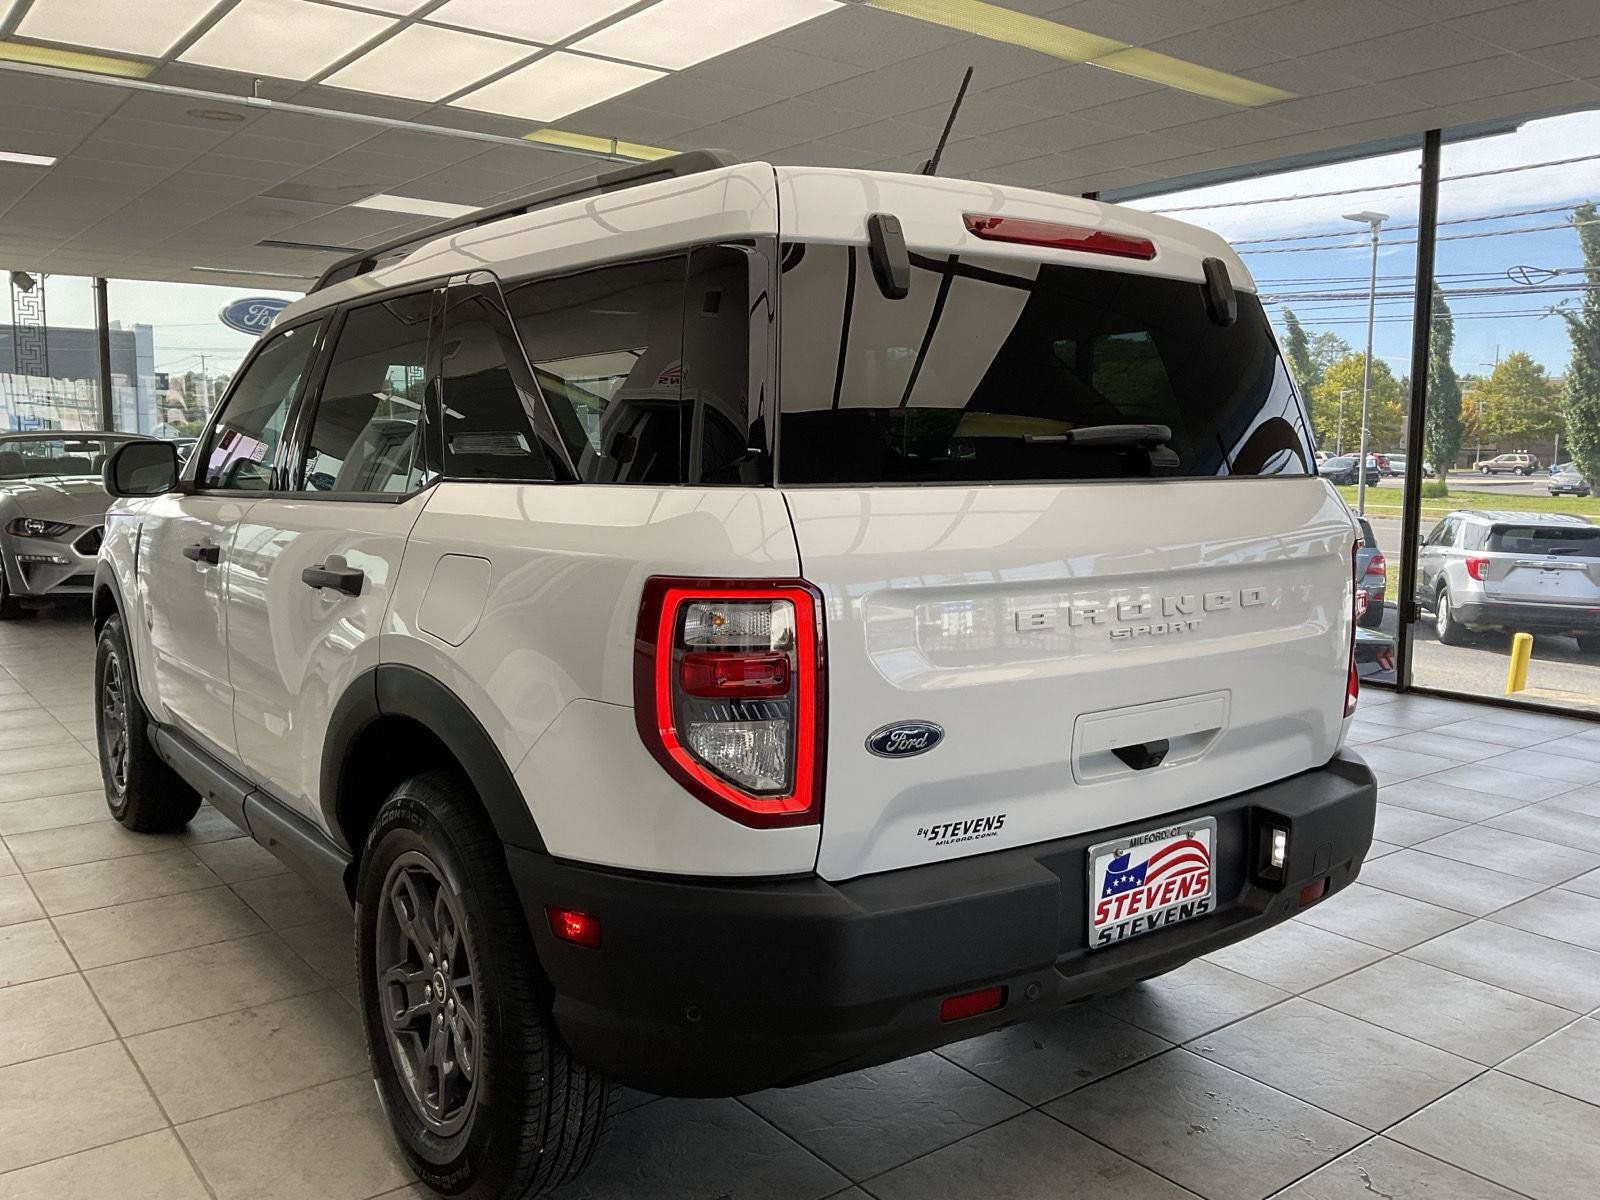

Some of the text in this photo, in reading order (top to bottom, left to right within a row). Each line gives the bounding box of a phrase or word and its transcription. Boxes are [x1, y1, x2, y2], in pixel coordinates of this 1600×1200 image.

[244, 304, 284, 326] Fo
[1015, 587, 1266, 632] BRONCO
[1109, 619, 1201, 640] SPORT
[885, 729, 929, 752] Ford
[928, 814, 1006, 841] STEVENS
[1170, 827, 1181, 837] CT
[1094, 870, 1210, 926] STEVENS
[1097, 898, 1210, 947] STEVENS
